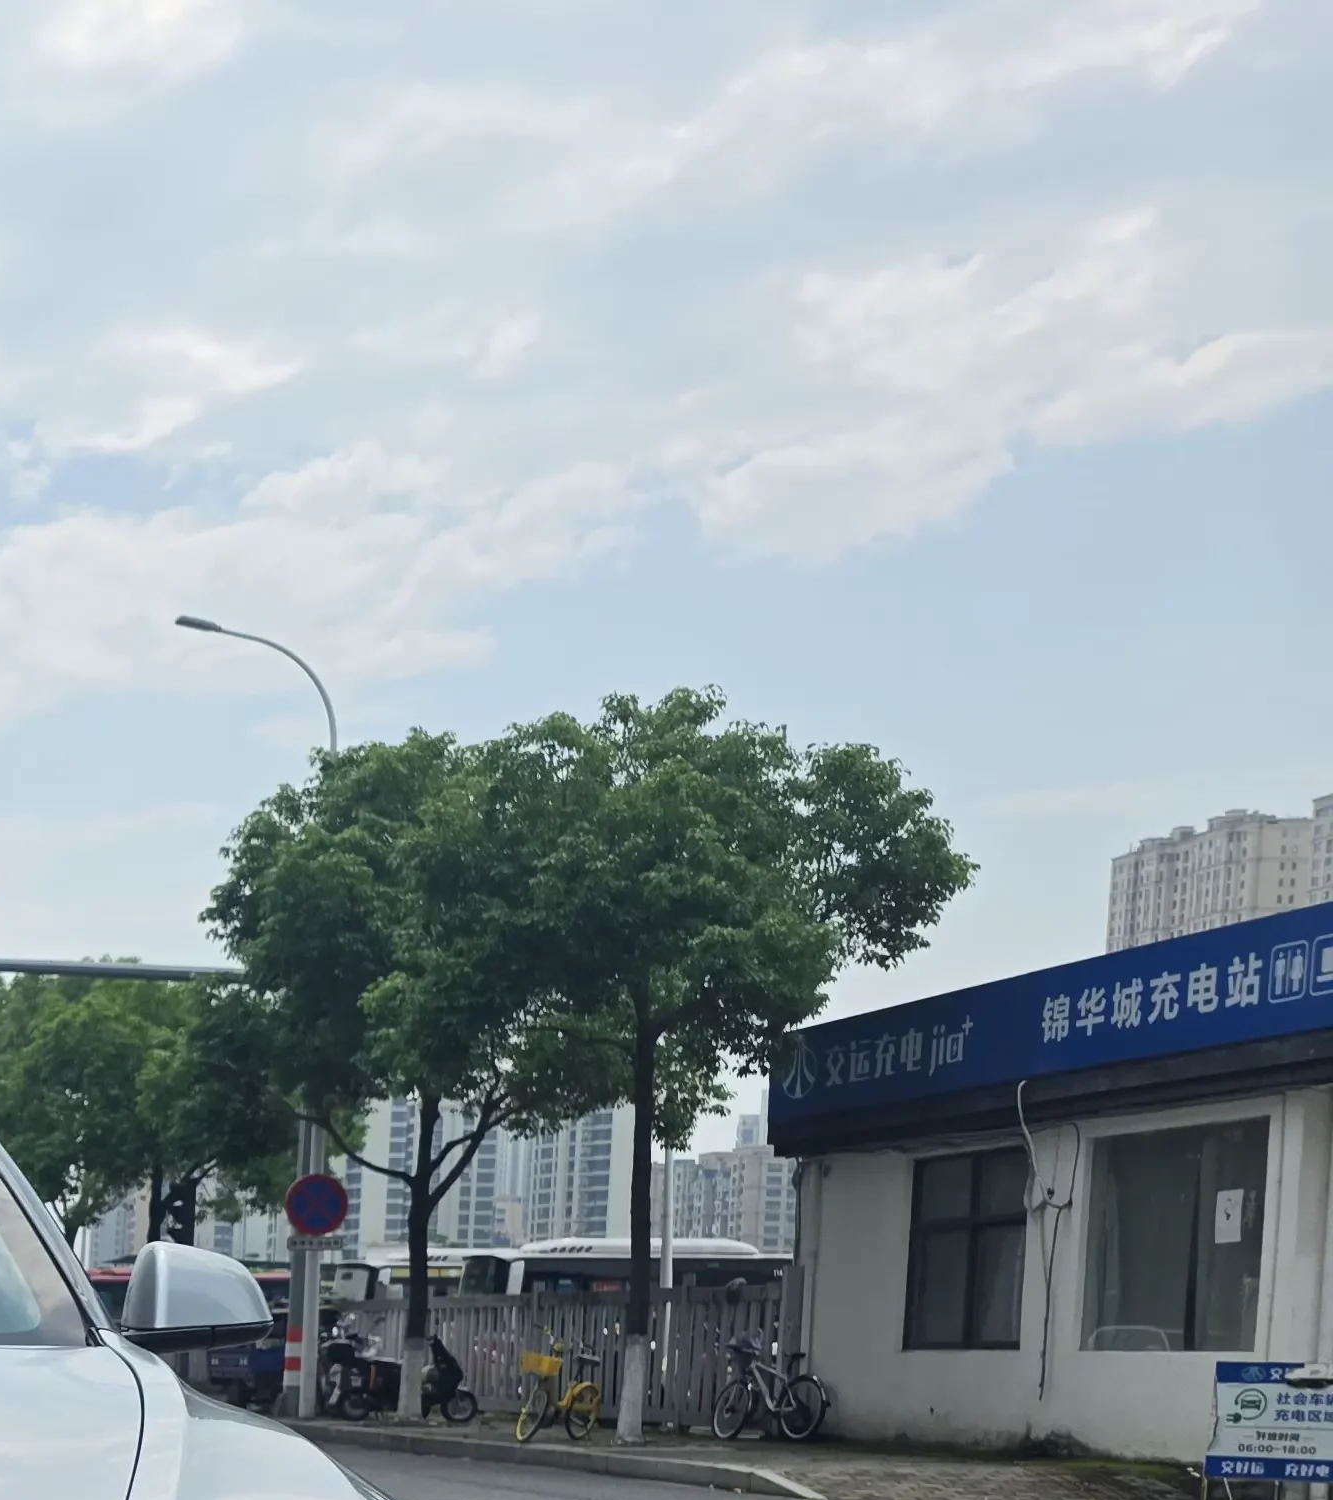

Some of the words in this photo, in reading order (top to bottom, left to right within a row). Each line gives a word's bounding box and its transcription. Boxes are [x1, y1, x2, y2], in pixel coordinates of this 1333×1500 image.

[1041, 951, 1263, 1044] 锦华城充电站
[825, 1027, 924, 1087] 交运充电
